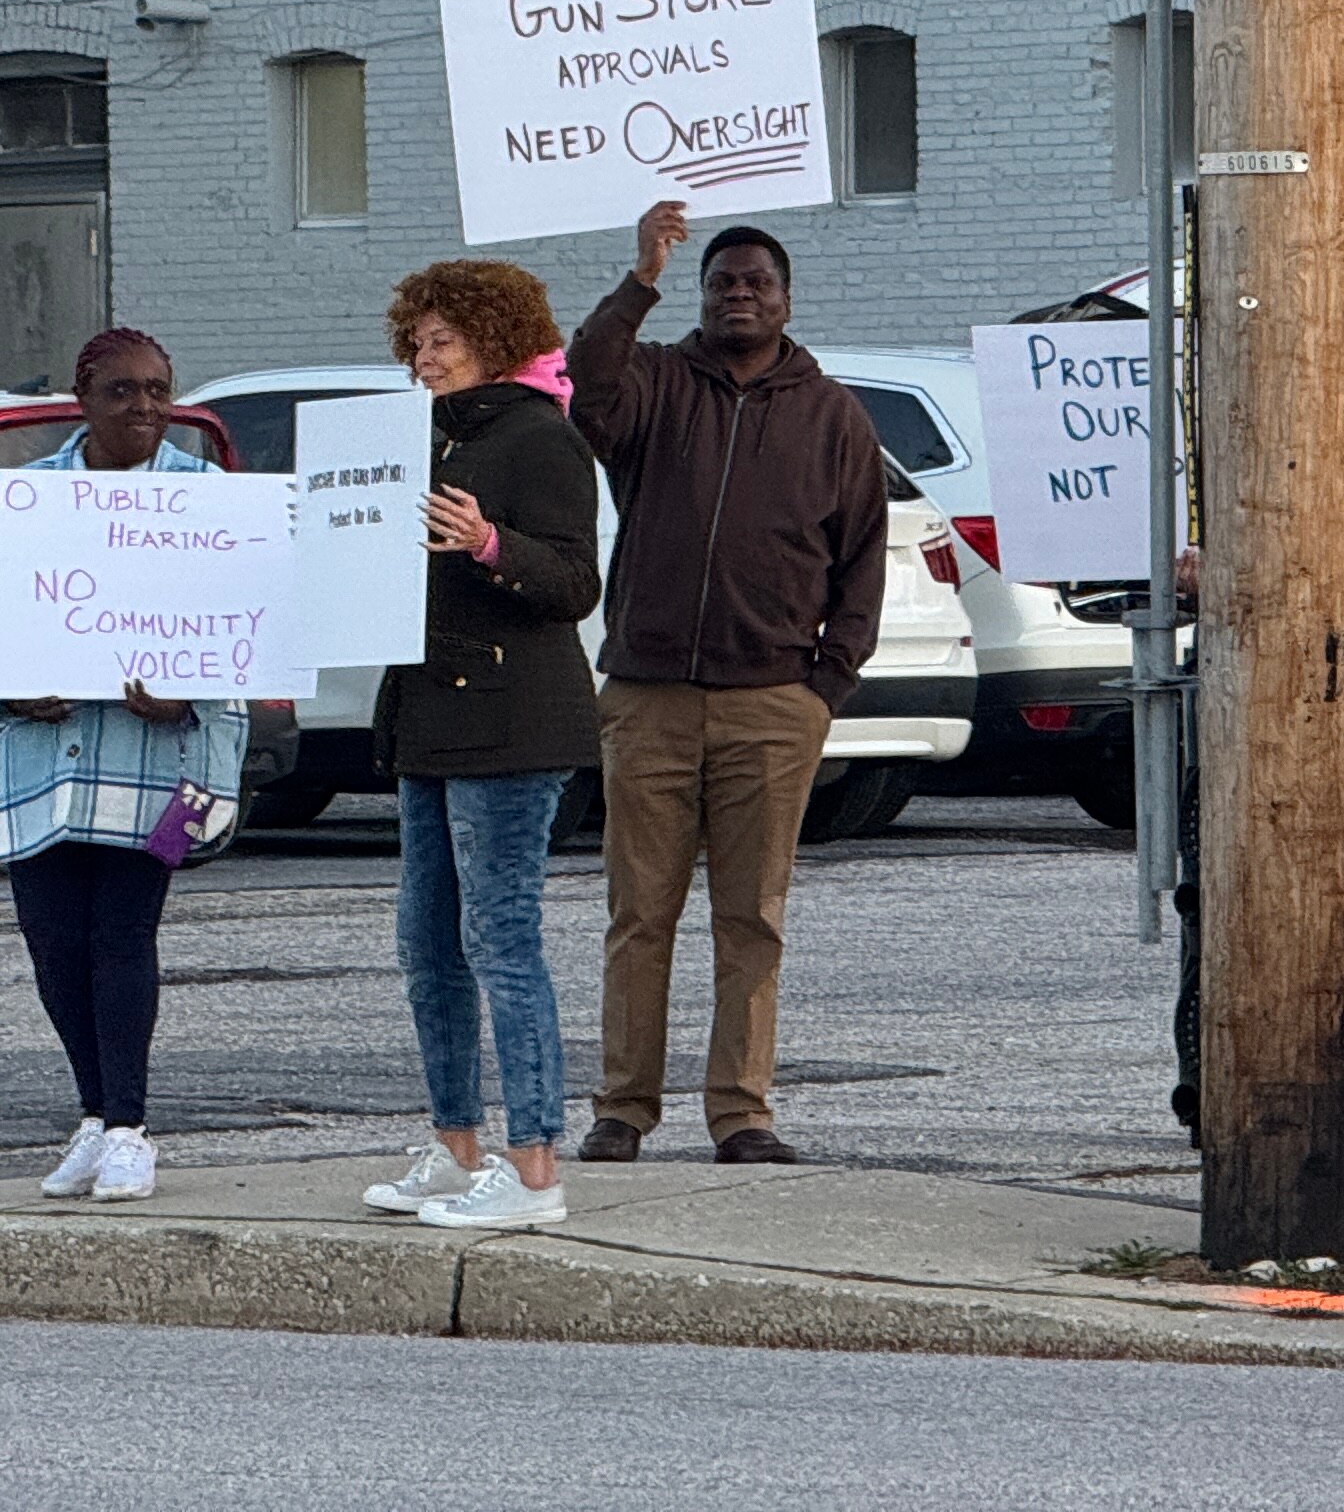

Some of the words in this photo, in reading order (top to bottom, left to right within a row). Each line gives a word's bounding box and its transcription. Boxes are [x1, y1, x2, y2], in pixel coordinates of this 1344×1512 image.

[558, 39, 730, 89] APPROVALS
[505, 123, 606, 164] NEED
[1228, 155, 1294, 171] 600615
[1063, 401, 1150, 441] OUR
[5, 479, 37, 511] O
[70, 479, 189, 514] PUBLIC
[1048, 464, 1118, 503] NOT
[34, 569, 98, 602] NO
[65, 606, 266, 639] COMMUNITY
